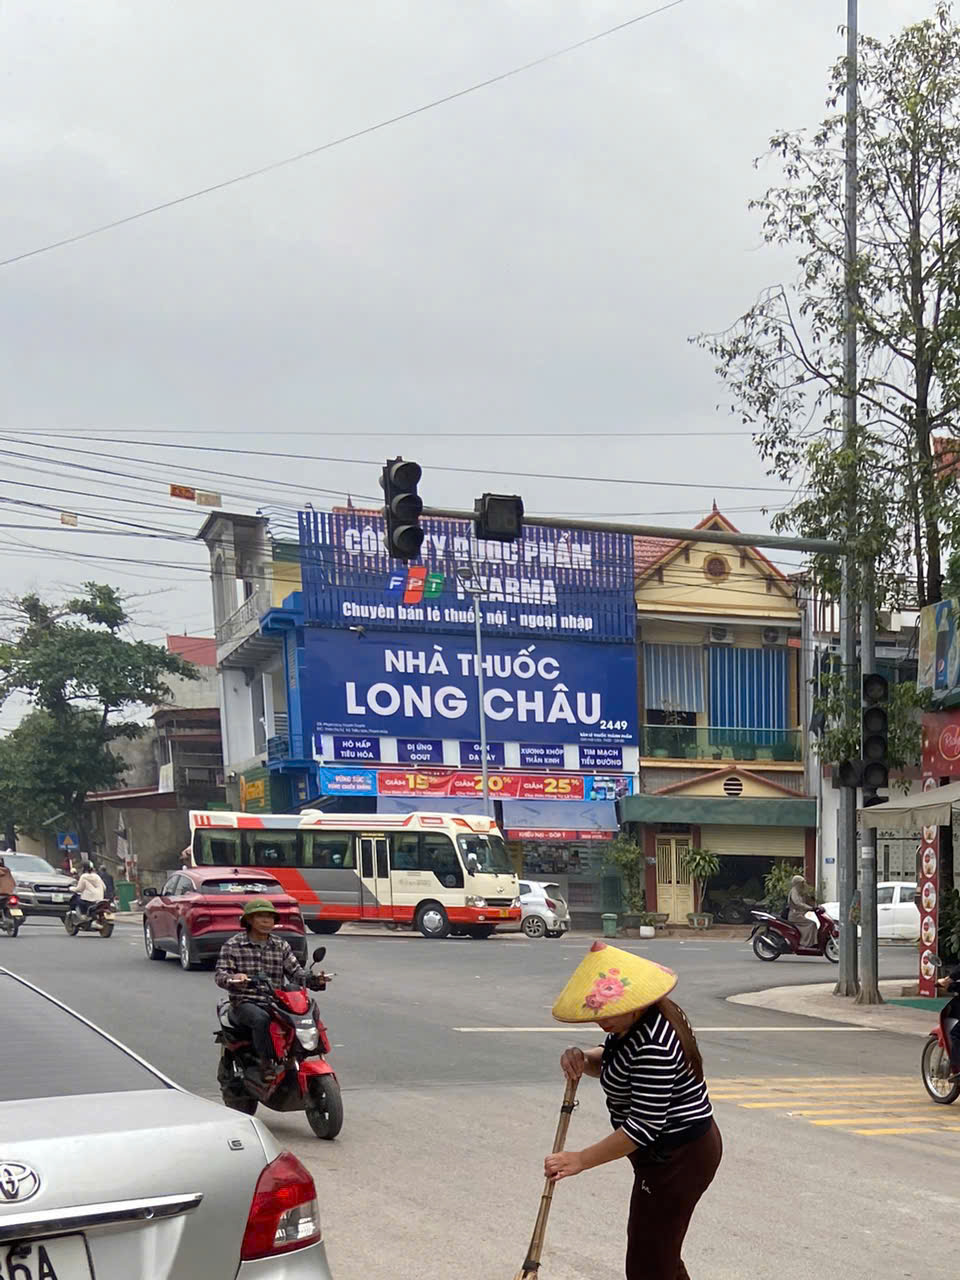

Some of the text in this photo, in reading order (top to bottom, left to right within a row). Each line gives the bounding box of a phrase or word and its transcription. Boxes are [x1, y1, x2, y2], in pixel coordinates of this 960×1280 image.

[345, 526, 390, 558] CÔN
[524, 532, 592, 570] PHẨM
[456, 575, 557, 605] PHARMA
[342, 602, 396, 621] Chuyên
[397, 605, 425, 621] bán
[426, 606, 442, 622] lẻ
[486, 610, 508, 627] nội
[519, 613, 557, 630] ngoại
[560, 615, 593, 632] nhập
[385, 644, 560, 680] NHÀ THUỐC
[345, 682, 601, 725] LONG CHÂU
[600, 720, 629, 731] 2449
[410, 753, 431, 761] GOUT
[583, 748, 598, 756] TIM
